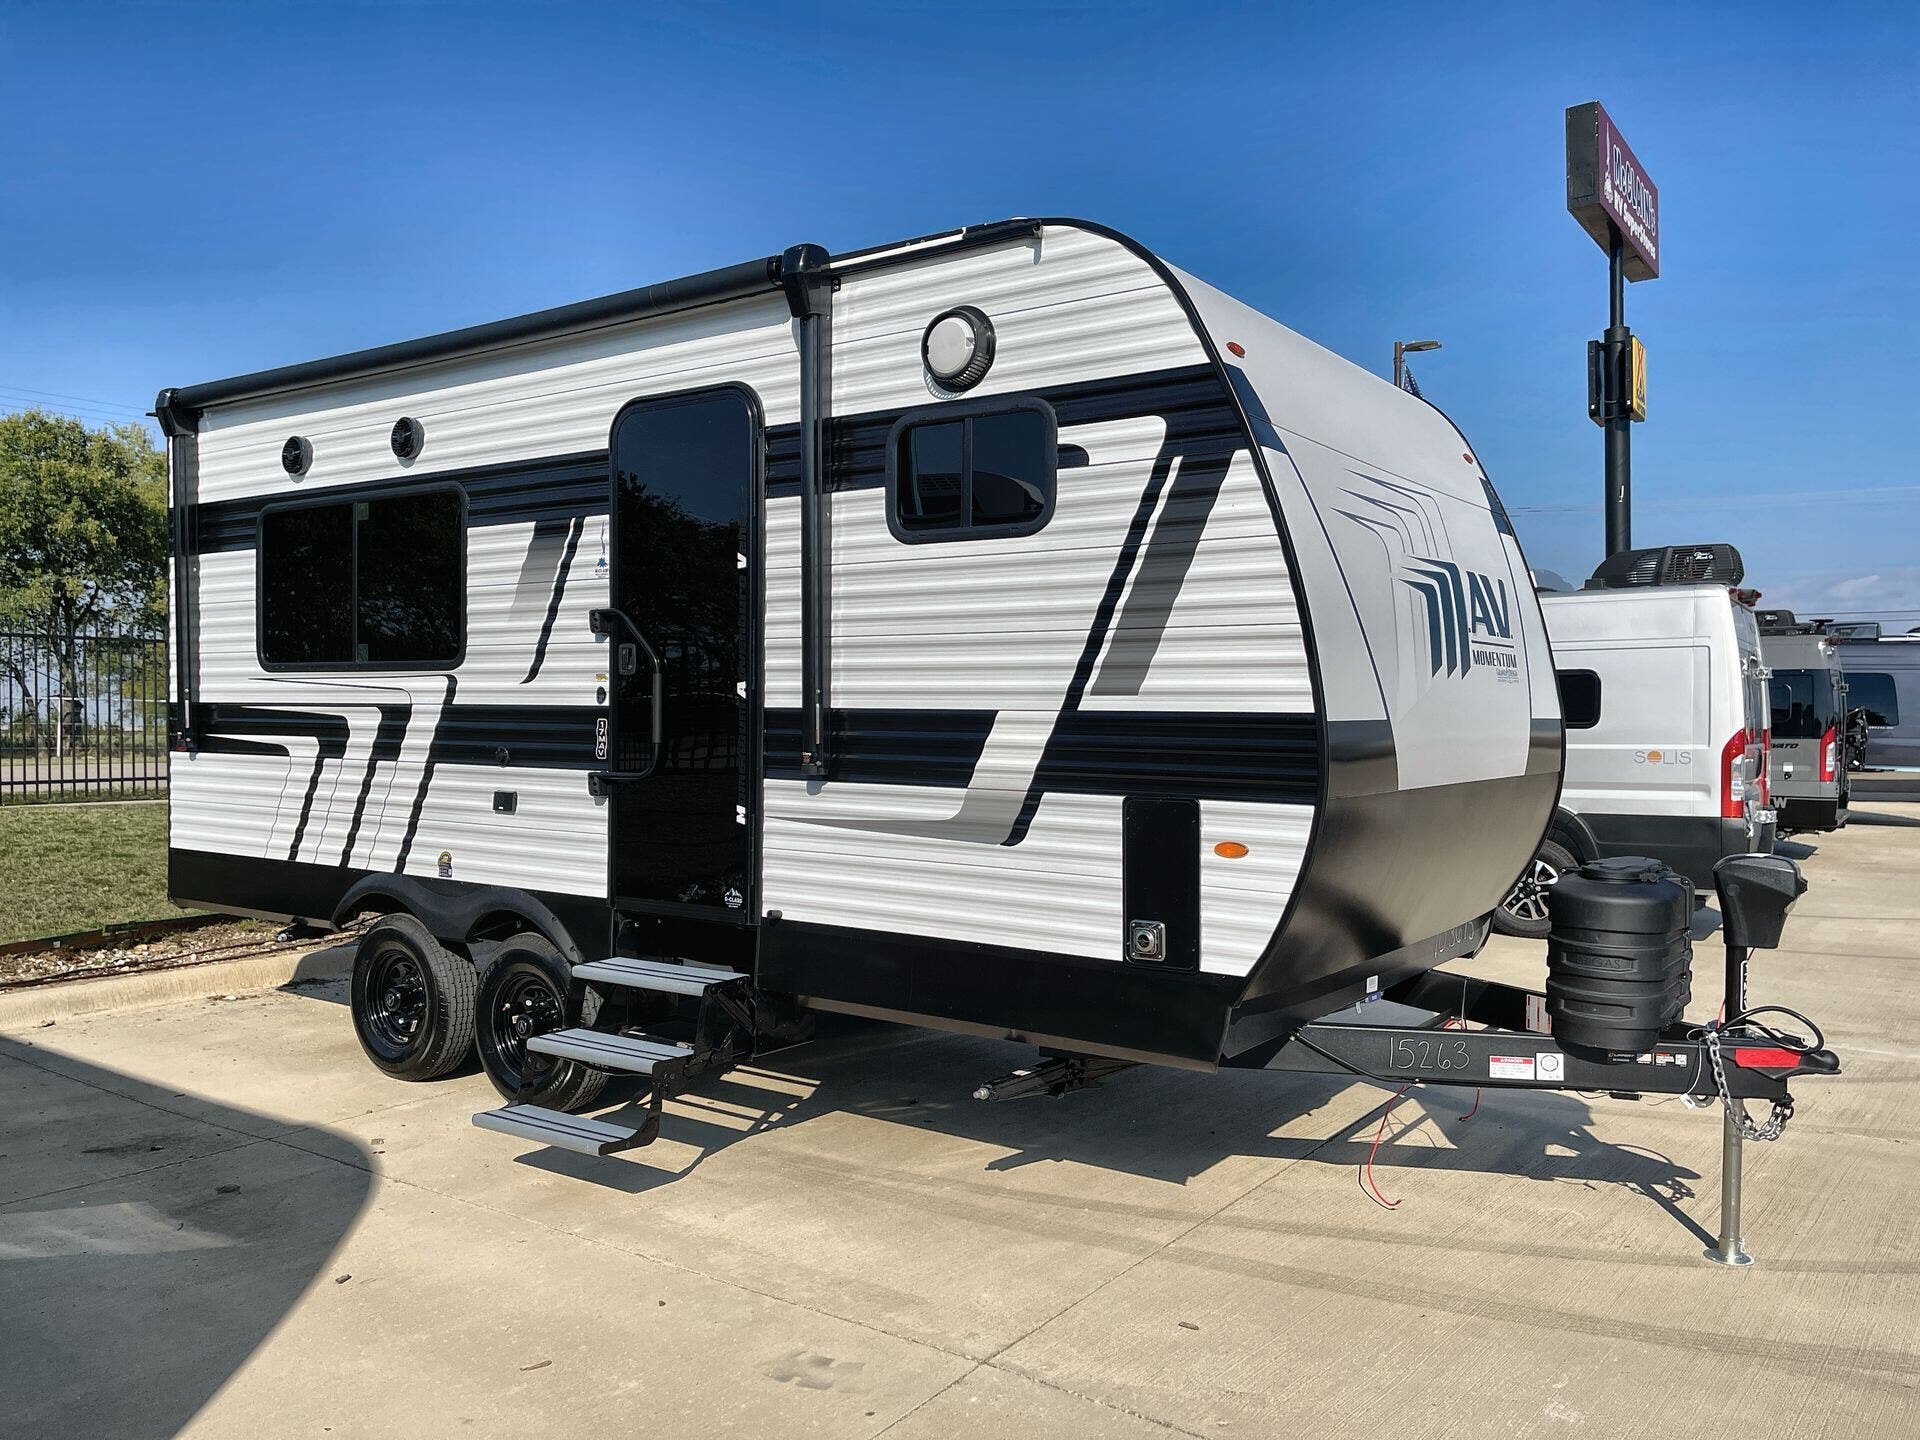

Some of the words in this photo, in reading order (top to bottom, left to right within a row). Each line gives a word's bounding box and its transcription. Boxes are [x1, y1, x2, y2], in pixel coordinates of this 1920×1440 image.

[1614, 189, 1623, 217] RV
[1472, 649, 1518, 669] MOMENTUM
[1633, 748, 1692, 765] SOLIS
[1592, 957, 1622, 969] GAS
[1388, 1036, 1471, 1070] 15263
